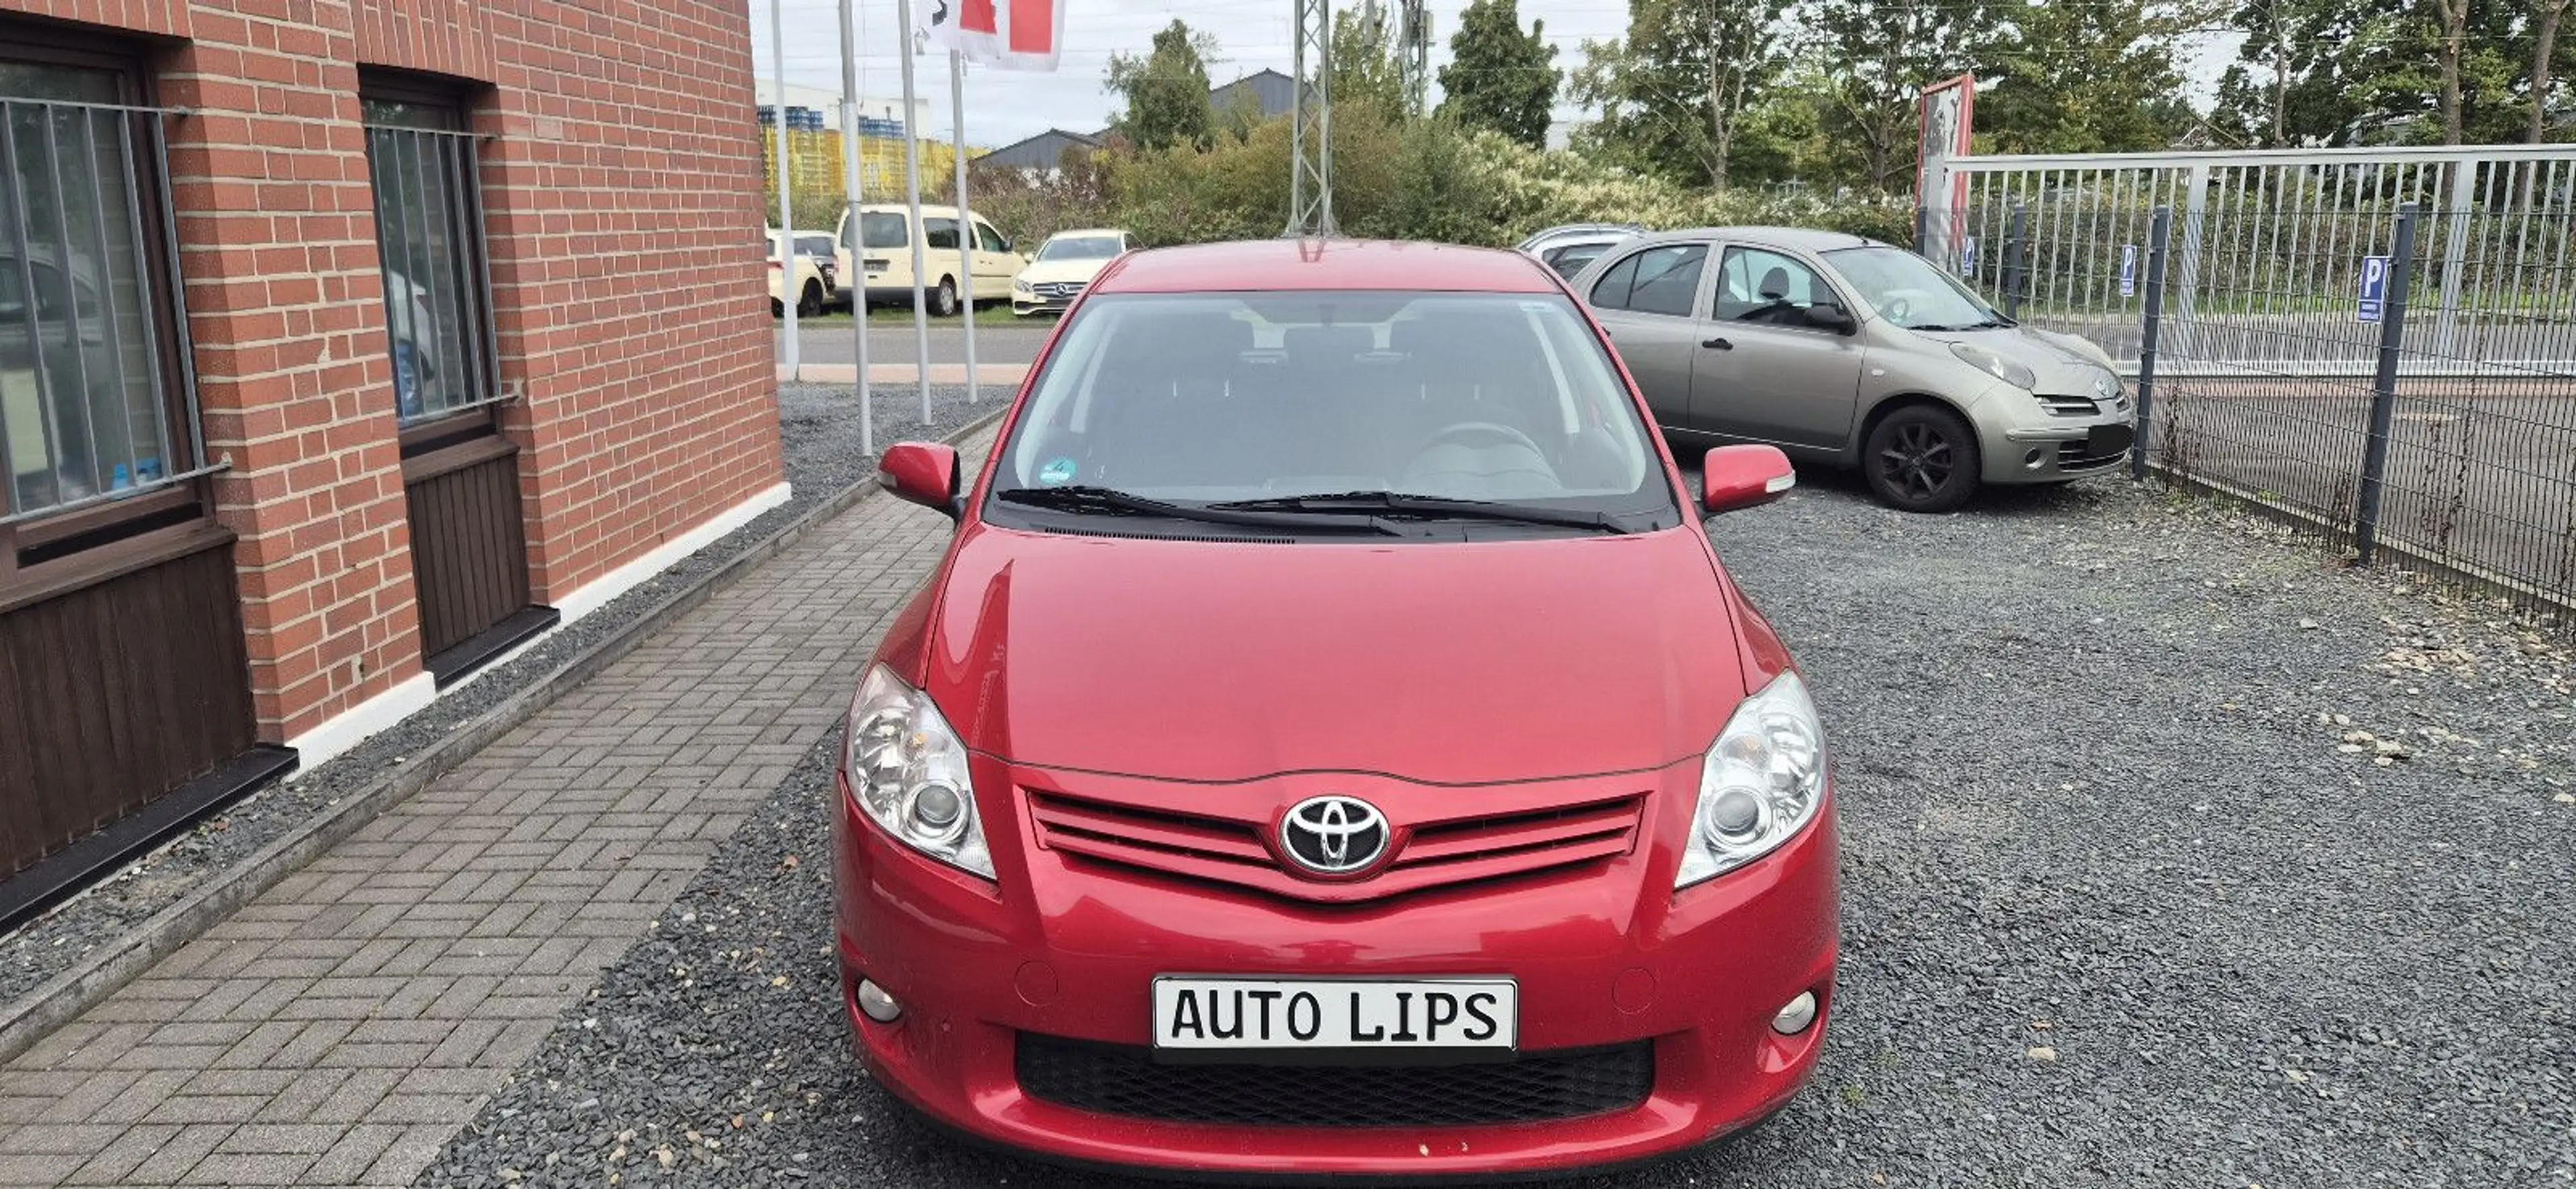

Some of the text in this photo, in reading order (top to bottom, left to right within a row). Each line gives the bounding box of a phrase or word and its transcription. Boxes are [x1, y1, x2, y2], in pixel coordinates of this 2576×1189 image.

[2123, 247, 2133, 277] P
[2365, 259, 2381, 297] P
[1053, 461, 1064, 472] 4
[1171, 989, 1497, 1042] AUTO LIPS
